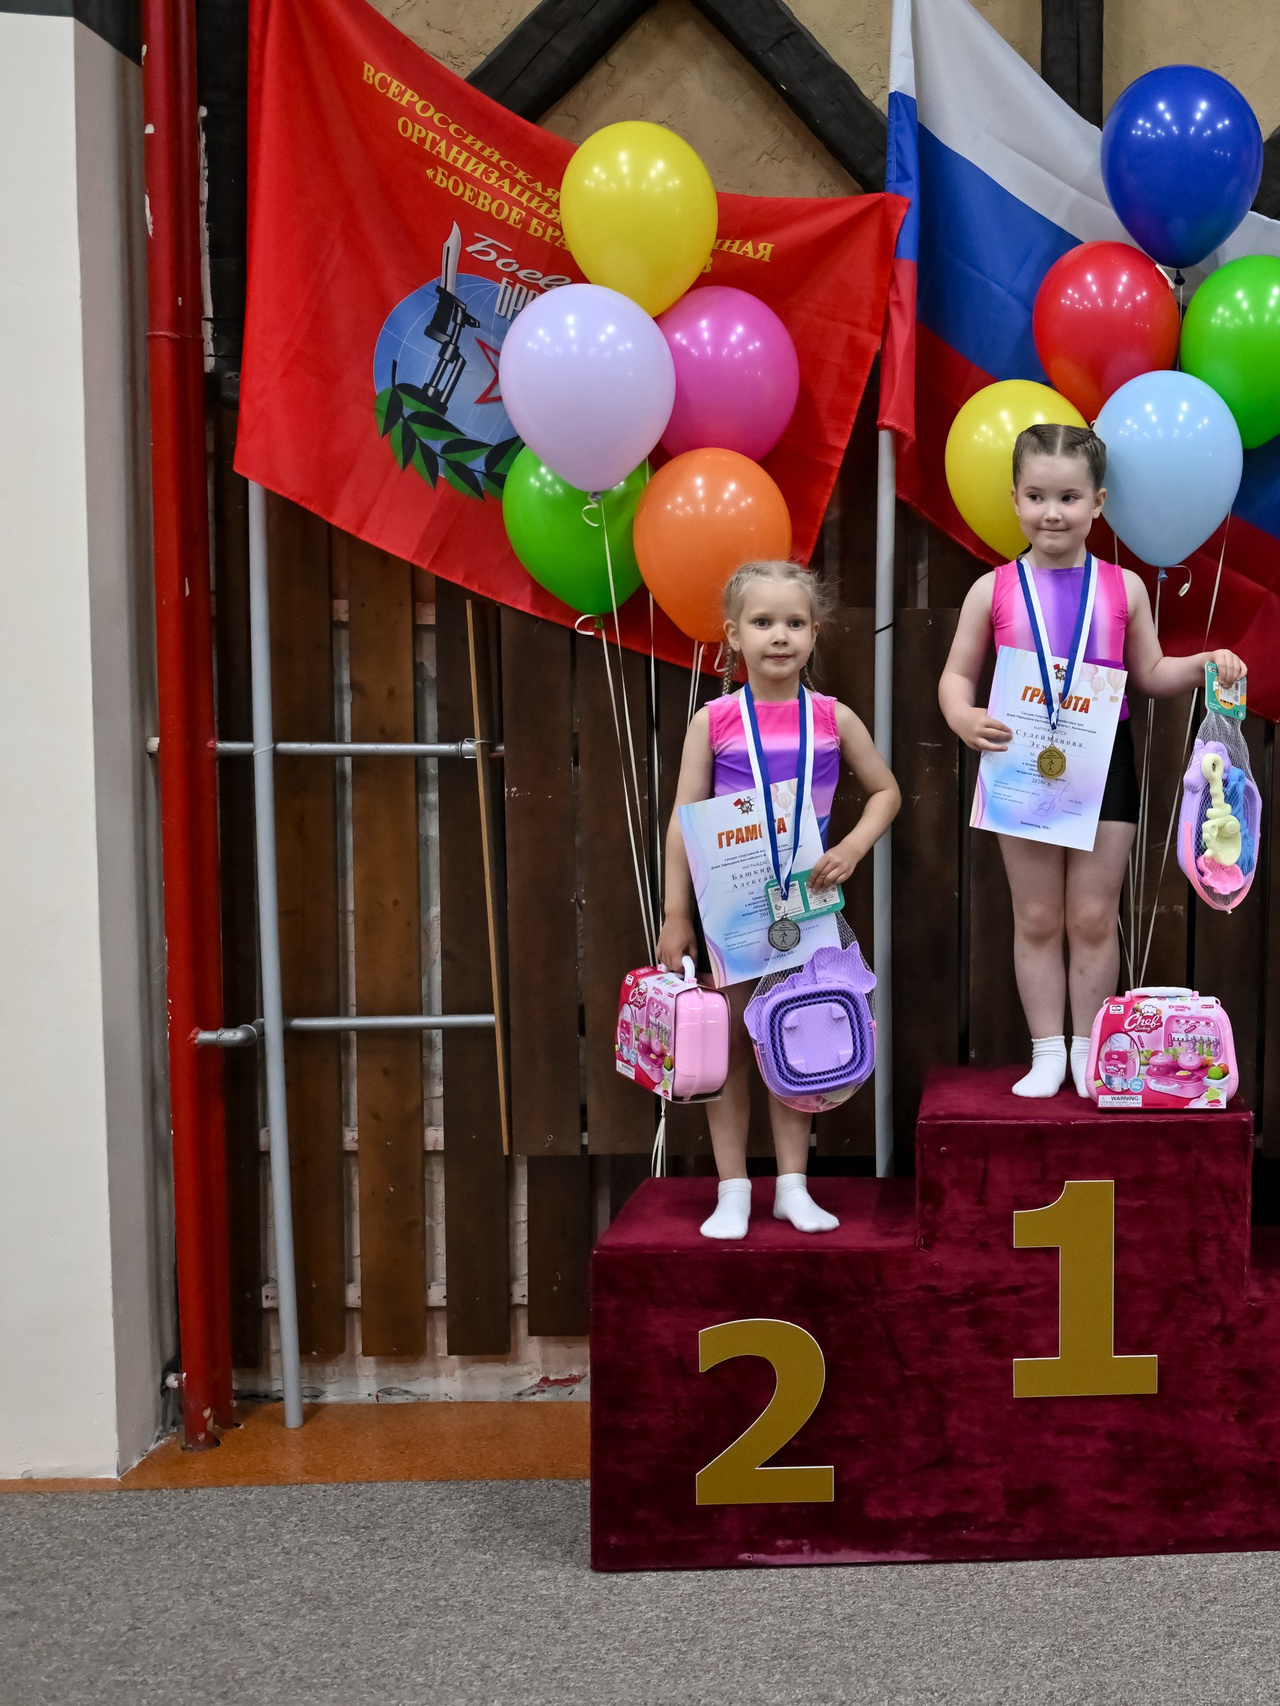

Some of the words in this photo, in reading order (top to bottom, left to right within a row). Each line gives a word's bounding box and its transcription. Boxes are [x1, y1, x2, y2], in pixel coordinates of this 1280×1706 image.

[362, 61, 560, 203] ВСЕРОССИЙСКАЯ
[397, 116, 562, 226] ОРГАНИЗАЦИЯ
[426, 166, 526, 229] «БОЕВОЕ
[1021, 686, 1091, 714] ГРАОТА
[717, 817, 787, 849] ГРАМА
[1124, 1014, 1160, 1029] Chef
[1012, 1179, 1159, 1399] 1
[695, 1318, 835, 1507] 2
